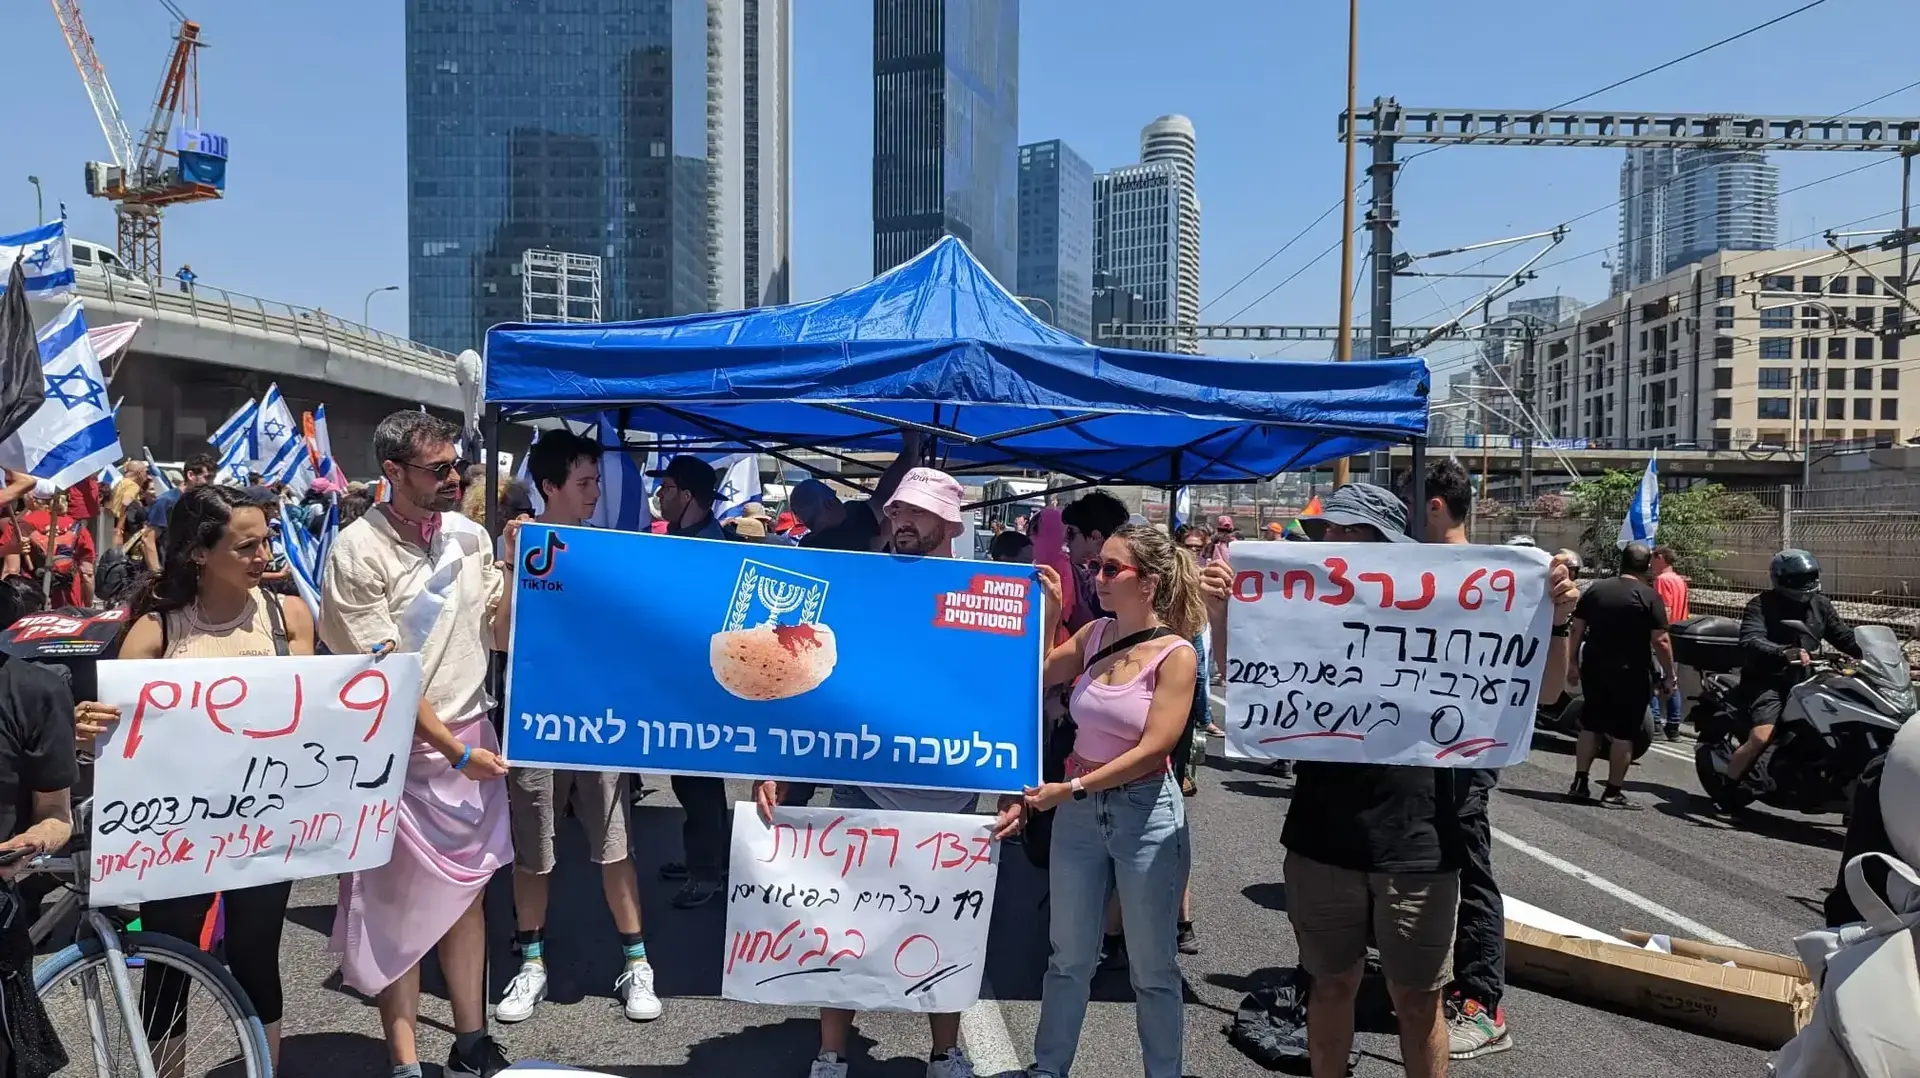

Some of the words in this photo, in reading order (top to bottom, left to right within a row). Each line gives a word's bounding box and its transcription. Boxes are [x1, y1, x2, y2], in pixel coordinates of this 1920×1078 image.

[522, 579, 563, 591] TikTok
[945, 592, 1023, 613] הסטודנטיות
[983, 580, 1024, 598] מחאת
[1232, 557, 1436, 611] נרצחים
[1458, 568, 1516, 612] 69
[944, 608, 1021, 630] והסטודנטים
[1343, 622, 1539, 668] מהחברה
[339, 669, 389, 742] 9
[1380, 668, 1531, 707] הערבית
[123, 674, 302, 759] נשים
[521, 708, 627, 745] לאומי
[1240, 690, 1400, 734] במשילות
[637, 720, 758, 755] ביטחון
[768, 724, 881, 760] לחוסר
[893, 731, 1017, 769] הלשכה
[242, 742, 395, 792] נרצחו
[205, 823, 274, 874] אזיק
[284, 812, 343, 863] חוק
[349, 799, 395, 860] אין
[756, 815, 900, 878] רקטות
[915, 831, 991, 873] 137
[731, 883, 840, 908] בפיגועים
[853, 885, 940, 914] נרצחים
[953, 889, 984, 921] 19
[726, 919, 866, 975] בביטחון
